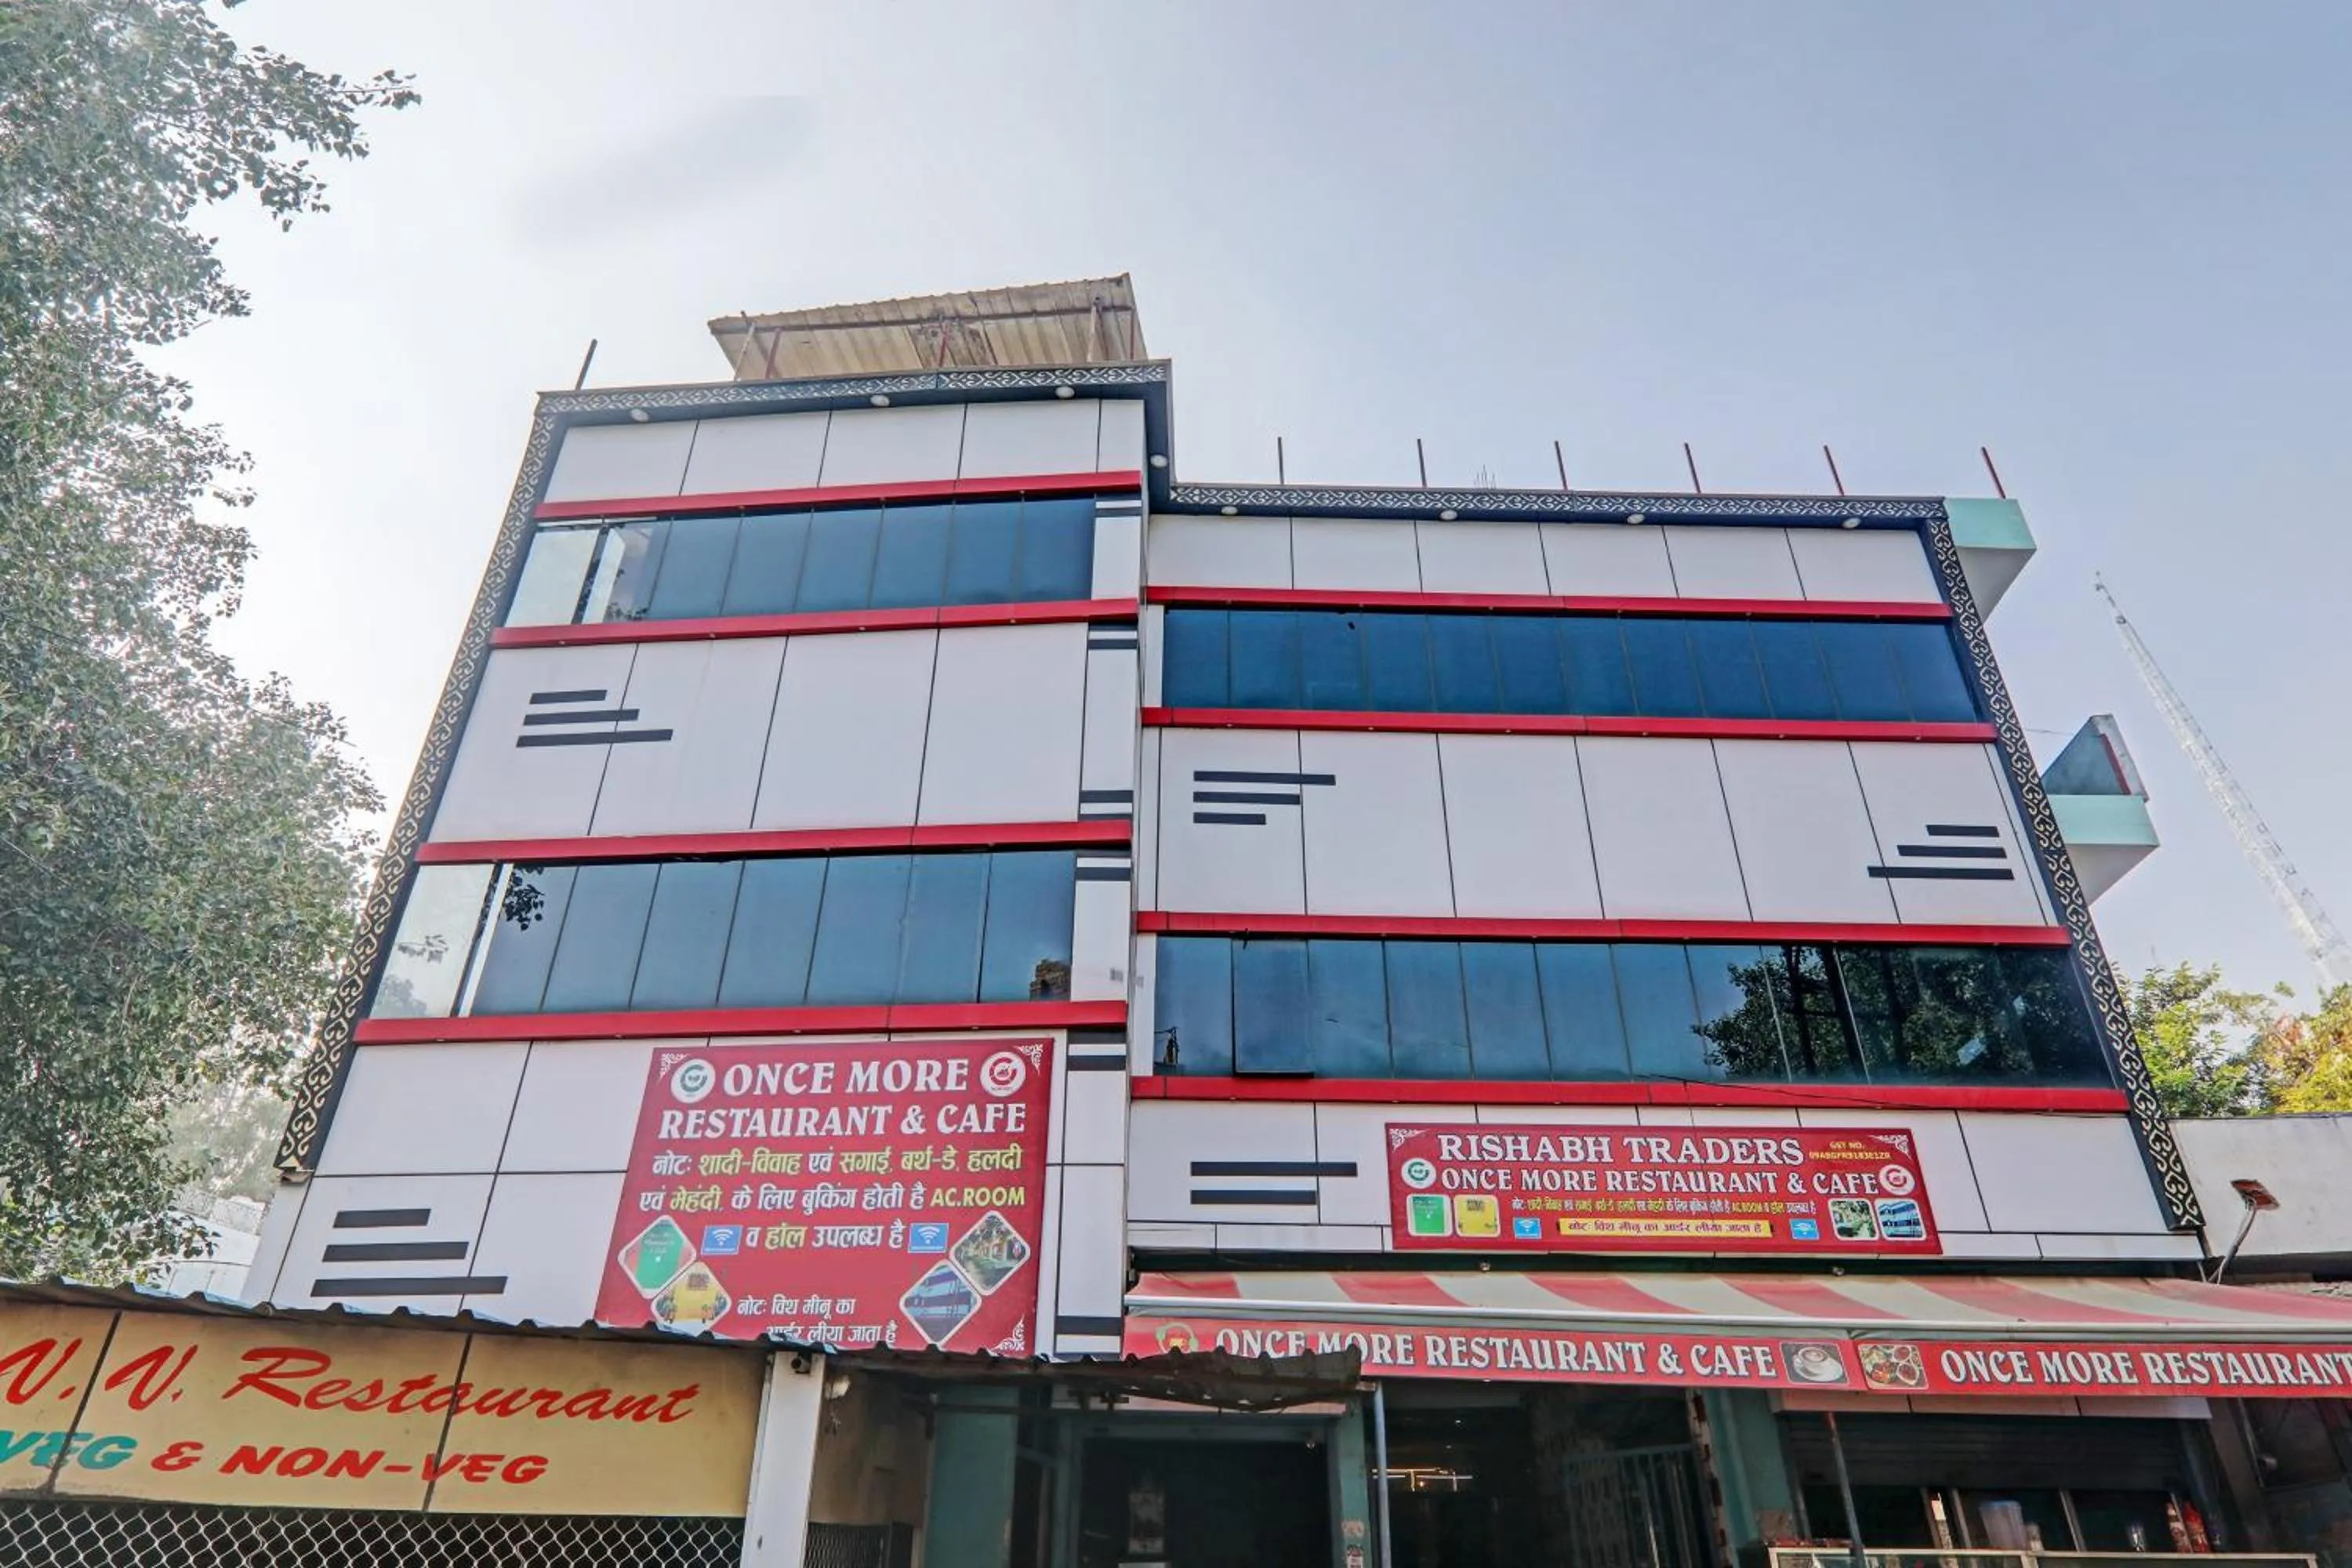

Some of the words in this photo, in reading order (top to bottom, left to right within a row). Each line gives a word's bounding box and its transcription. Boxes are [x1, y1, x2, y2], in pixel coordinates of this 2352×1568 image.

[724, 1062, 835, 1096] ONCE
[845, 1058, 970, 1094] MORE
[658, 1106, 892, 1139] RESTAURANT
[900, 1104, 927, 1134] &
[937, 1103, 1027, 1134] CAFE
[809, 1145, 834, 1174] एवं
[967, 1142, 1023, 1173] हलदी
[1437, 1134, 1614, 1163] RISHABH
[1623, 1137, 1804, 1166] TRADERS
[640, 1185, 666, 1211] एवं
[731, 1185, 754, 1210] के
[758, 1182, 797, 1210] लिए
[802, 1181, 858, 1216] बुकिंग
[862, 1182, 906, 1210] होती
[909, 1180, 927, 1210] है
[930, 1187, 1025, 1207] AC.ROOM
[1442, 1168, 1512, 1190] ONCE
[1520, 1169, 1597, 1191] MORE
[1605, 1170, 1778, 1193] RESTAURANT
[1786, 1172, 1806, 1194] &
[1812, 1172, 1879, 1194] CAFE
[746, 1226, 761, 1247] व
[812, 1225, 885, 1248] उपलब्ध
[888, 1218, 907, 1249] है
[835, 1298, 857, 1315] का
[848, 1325, 882, 1342] जाता
[885, 1319, 898, 1344] है
[1216, 1328, 1305, 1359] ONCE
[1318, 1330, 1414, 1365] MORE
[1424, 1335, 1646, 1374] RESTAURANT
[1657, 1342, 1685, 1375] &
[1690, 1344, 1778, 1377] CAFE
[1940, 1348, 2034, 1383] ONCE
[2035, 1350, 2139, 1384] MORE
[2139, 1352, 2352, 1385] RESTAURANT
[222, 1347, 701, 1424] Restaurant
[0, 1429, 139, 1470] VEG
[151, 1441, 205, 1472] &
[218, 1445, 550, 1484] NON-VEG
